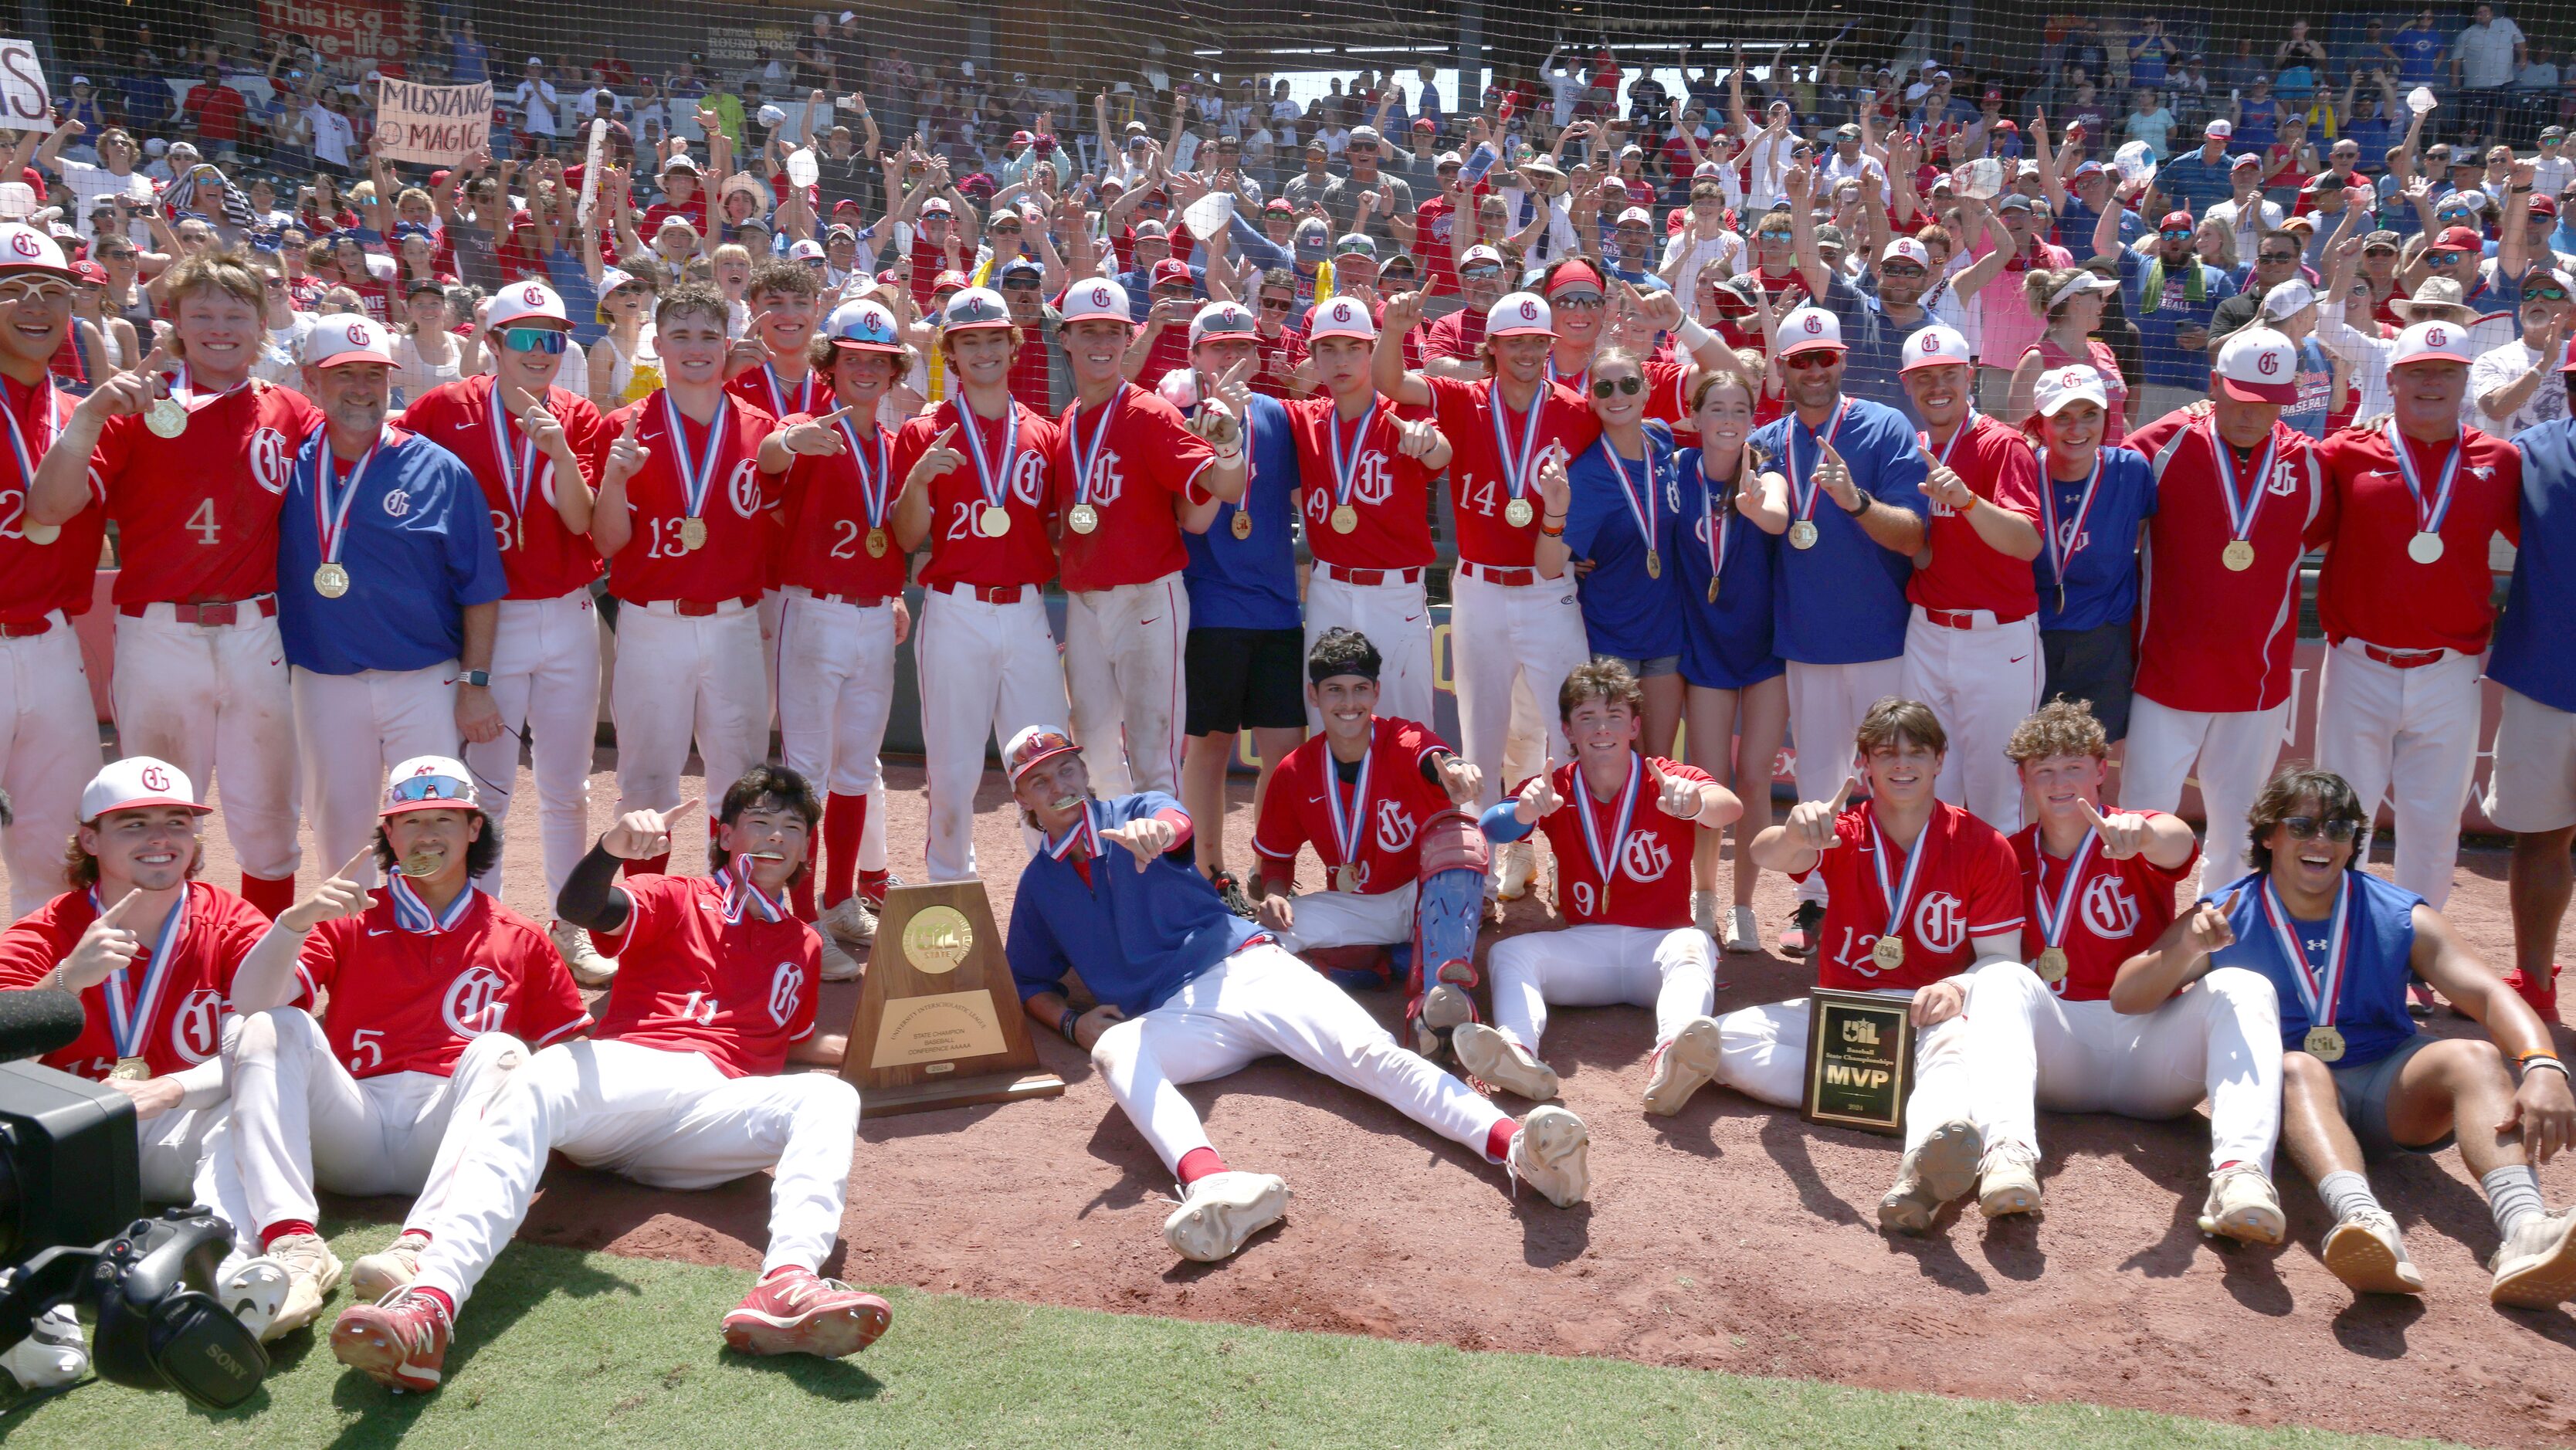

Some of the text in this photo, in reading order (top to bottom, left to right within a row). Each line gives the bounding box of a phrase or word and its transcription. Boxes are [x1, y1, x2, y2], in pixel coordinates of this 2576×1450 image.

[708, 37, 797, 51] ROUND ROCK
[754, 28, 784, 40] BBQ
[709, 49, 759, 60] EXPRE
[0, 46, 46, 120] S
[382, 80, 493, 117] MUSTANG
[408, 120, 482, 152] MAGIC
[12, 232, 41, 256] G
[524, 286, 545, 307] G
[1092, 287, 1110, 308] G
[1333, 303, 1351, 323] G
[1520, 300, 1537, 320] G
[347, 323, 370, 346] G
[1805, 315, 1822, 334] G
[2425, 327, 2446, 347] G
[1921, 334, 1940, 351] G
[2258, 351, 2279, 374] G
[250, 427, 293, 495] G
[1012, 449, 1047, 508] G
[1354, 450, 1393, 506] G
[383, 489, 409, 517] G
[1459, 473, 1496, 517] 14
[185, 497, 221, 544] 4
[1074, 511, 1092, 523] UIL
[648, 517, 690, 559] 13
[830, 520, 858, 559] 2
[1794, 528, 1812, 540] UIL
[322, 572, 342, 587] UIL
[142, 765, 170, 791] G
[1377, 798, 1417, 853] G
[1622, 829, 1673, 883] G
[1573, 881, 1595, 916] 9
[2080, 873, 2140, 939] G
[1914, 890, 1967, 954] G
[925, 950, 952, 959] STATE
[1833, 926, 1879, 977] 12
[1879, 944, 1898, 959] UIL
[442, 966, 509, 1039] G
[681, 991, 718, 1027] 11
[890, 1001, 987, 1040] UNIVERSITY INTERSCHOLASTIC LEAGUE
[933, 1028, 964, 1037] CHAMPION
[1842, 1018, 1880, 1045] UIL
[351, 1028, 385, 1072] 5
[908, 1046, 949, 1055] CONFERENCE
[924, 1037, 955, 1045] BASEBALL
[2312, 1035, 2337, 1051] UIL
[1843, 1054, 1894, 1065] Championships
[1826, 1065, 1890, 1089] MVP
[205, 1343, 248, 1381] SONY
